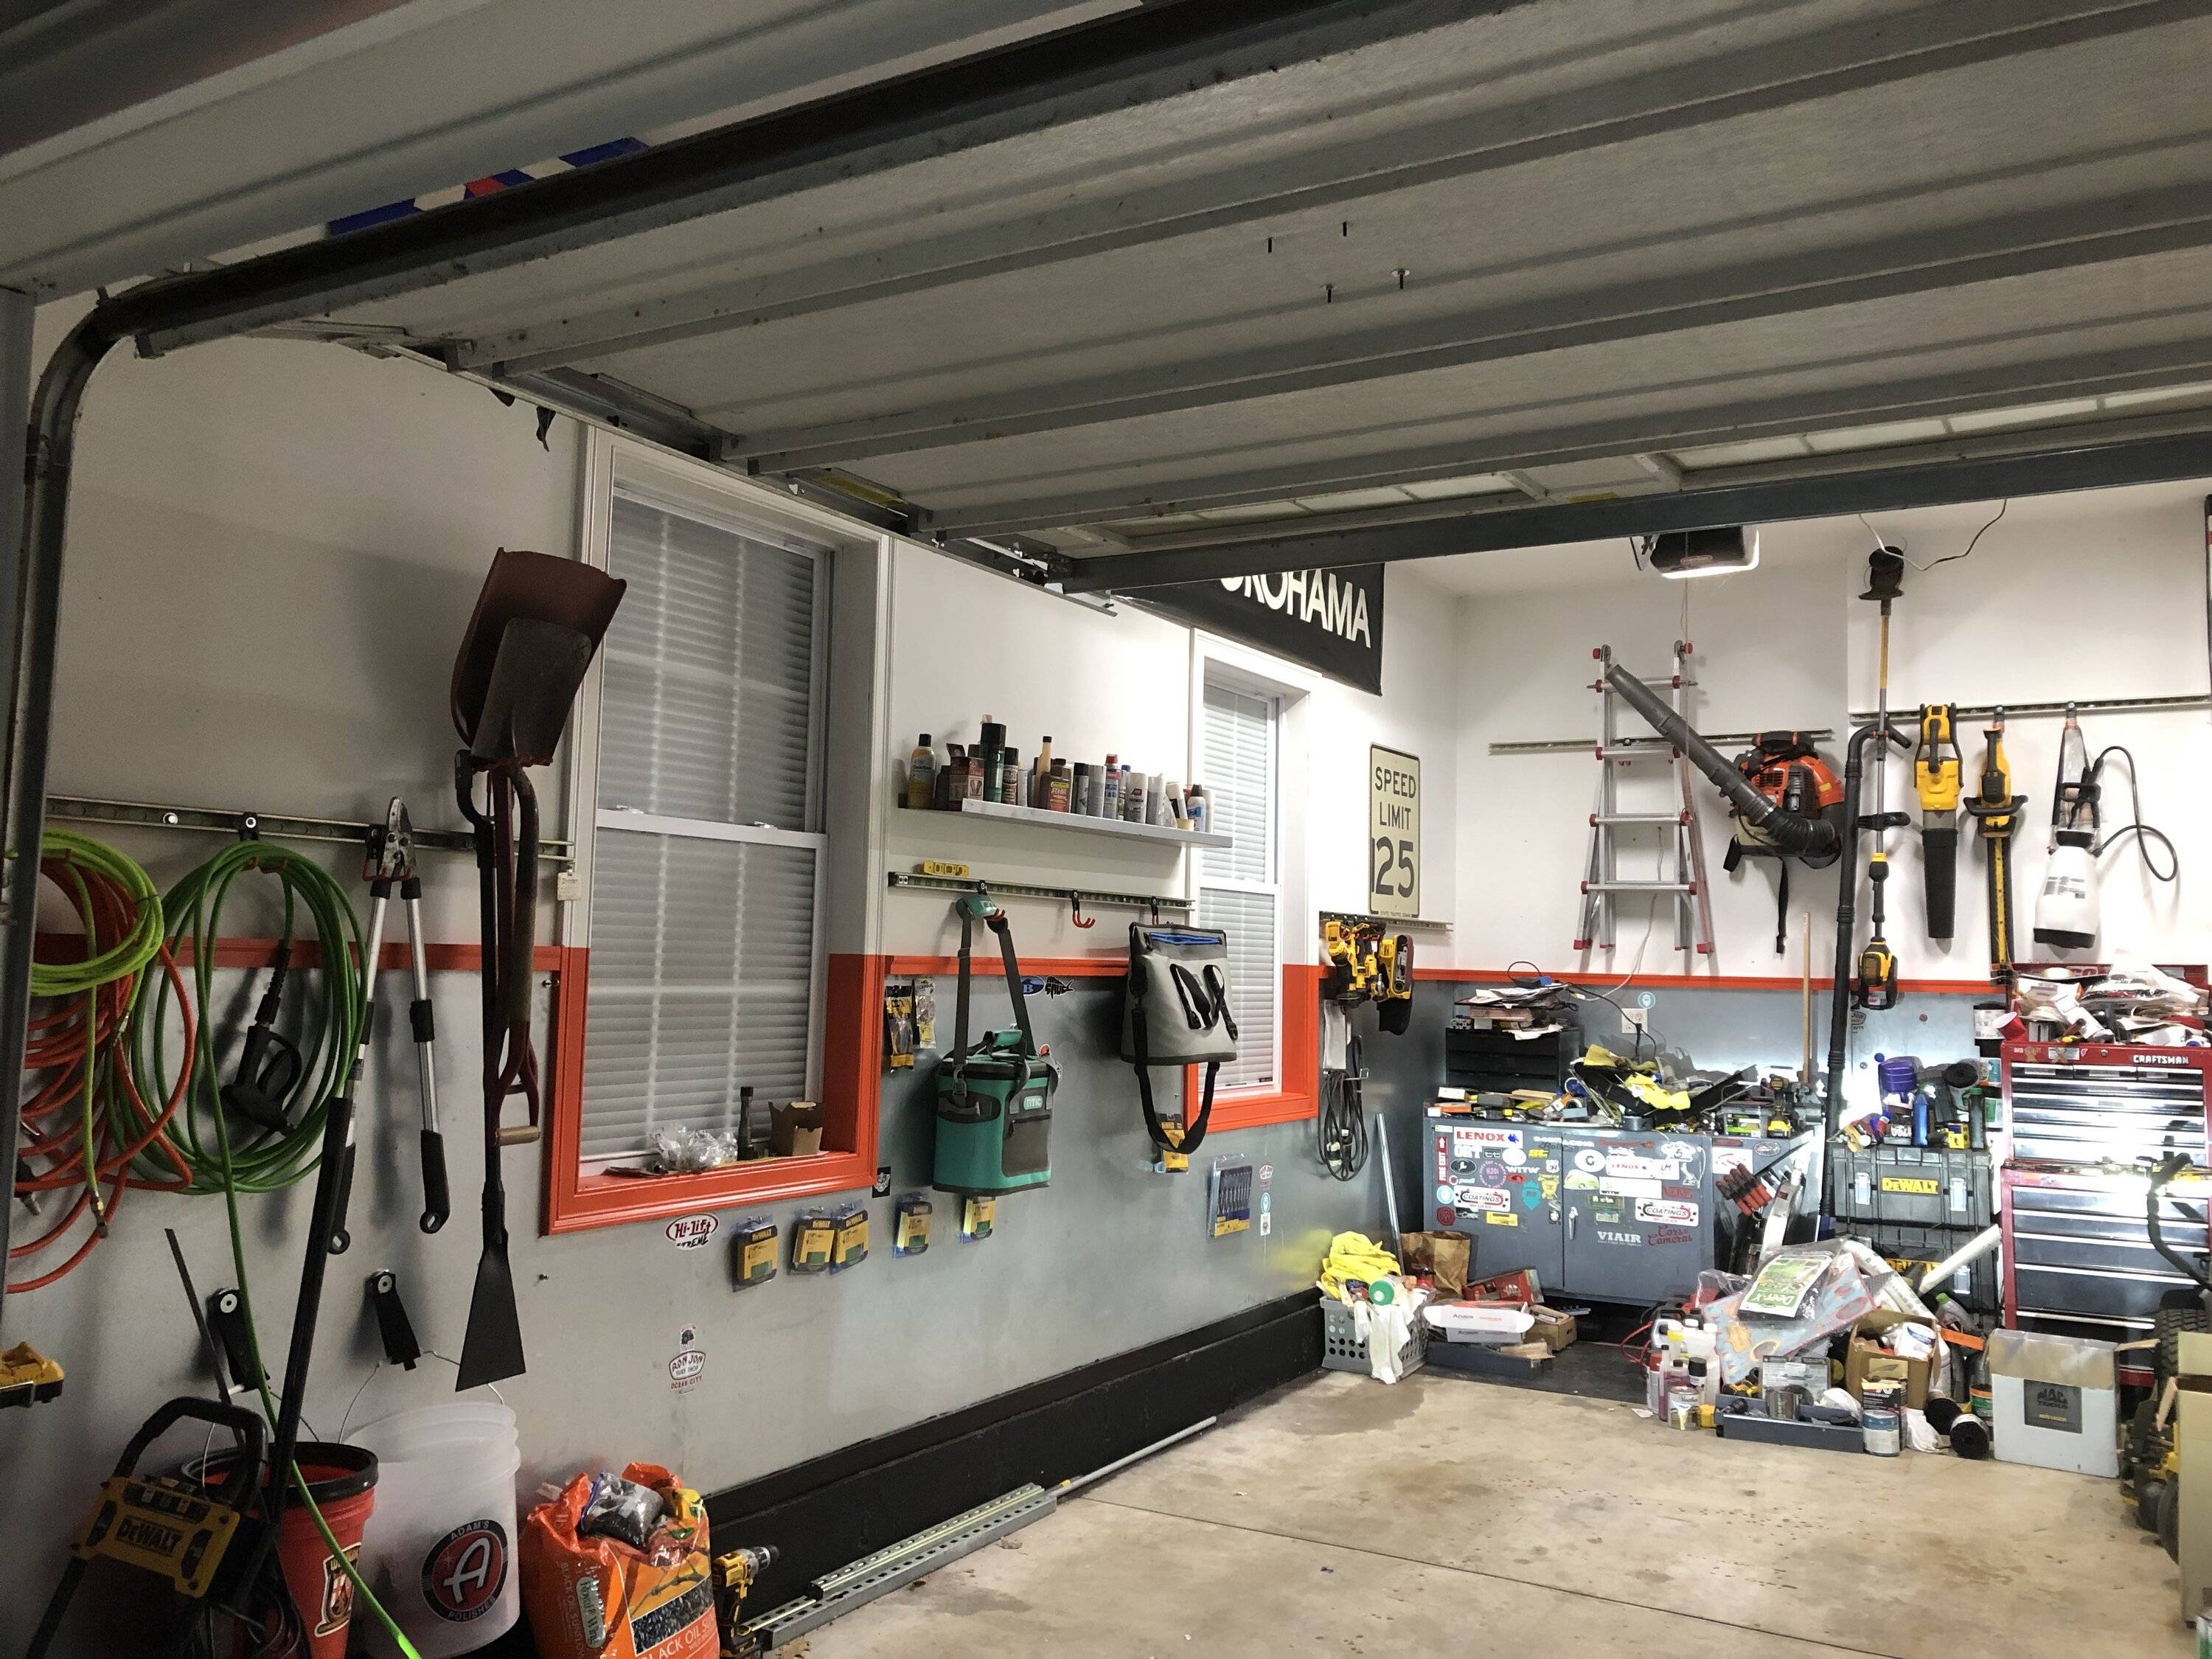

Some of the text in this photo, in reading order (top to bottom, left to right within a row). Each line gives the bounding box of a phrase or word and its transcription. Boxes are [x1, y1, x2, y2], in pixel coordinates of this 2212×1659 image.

[1374, 766, 1416, 799] SPEED
[1380, 801, 1411, 830] LIMIT
[1376, 835, 1415, 898] 25
[2133, 1054, 2189, 1065] CRAFTSMAN
[1456, 1131, 1506, 1142] LENOX
[1463, 1193, 1500, 1203] COATINGS
[1646, 1206, 1688, 1217] COATINGS
[674, 1218, 712, 1240] Hi-Lift
[1597, 1231, 1641, 1243] VIAIR
[1647, 1234, 1694, 1246] Cameras
